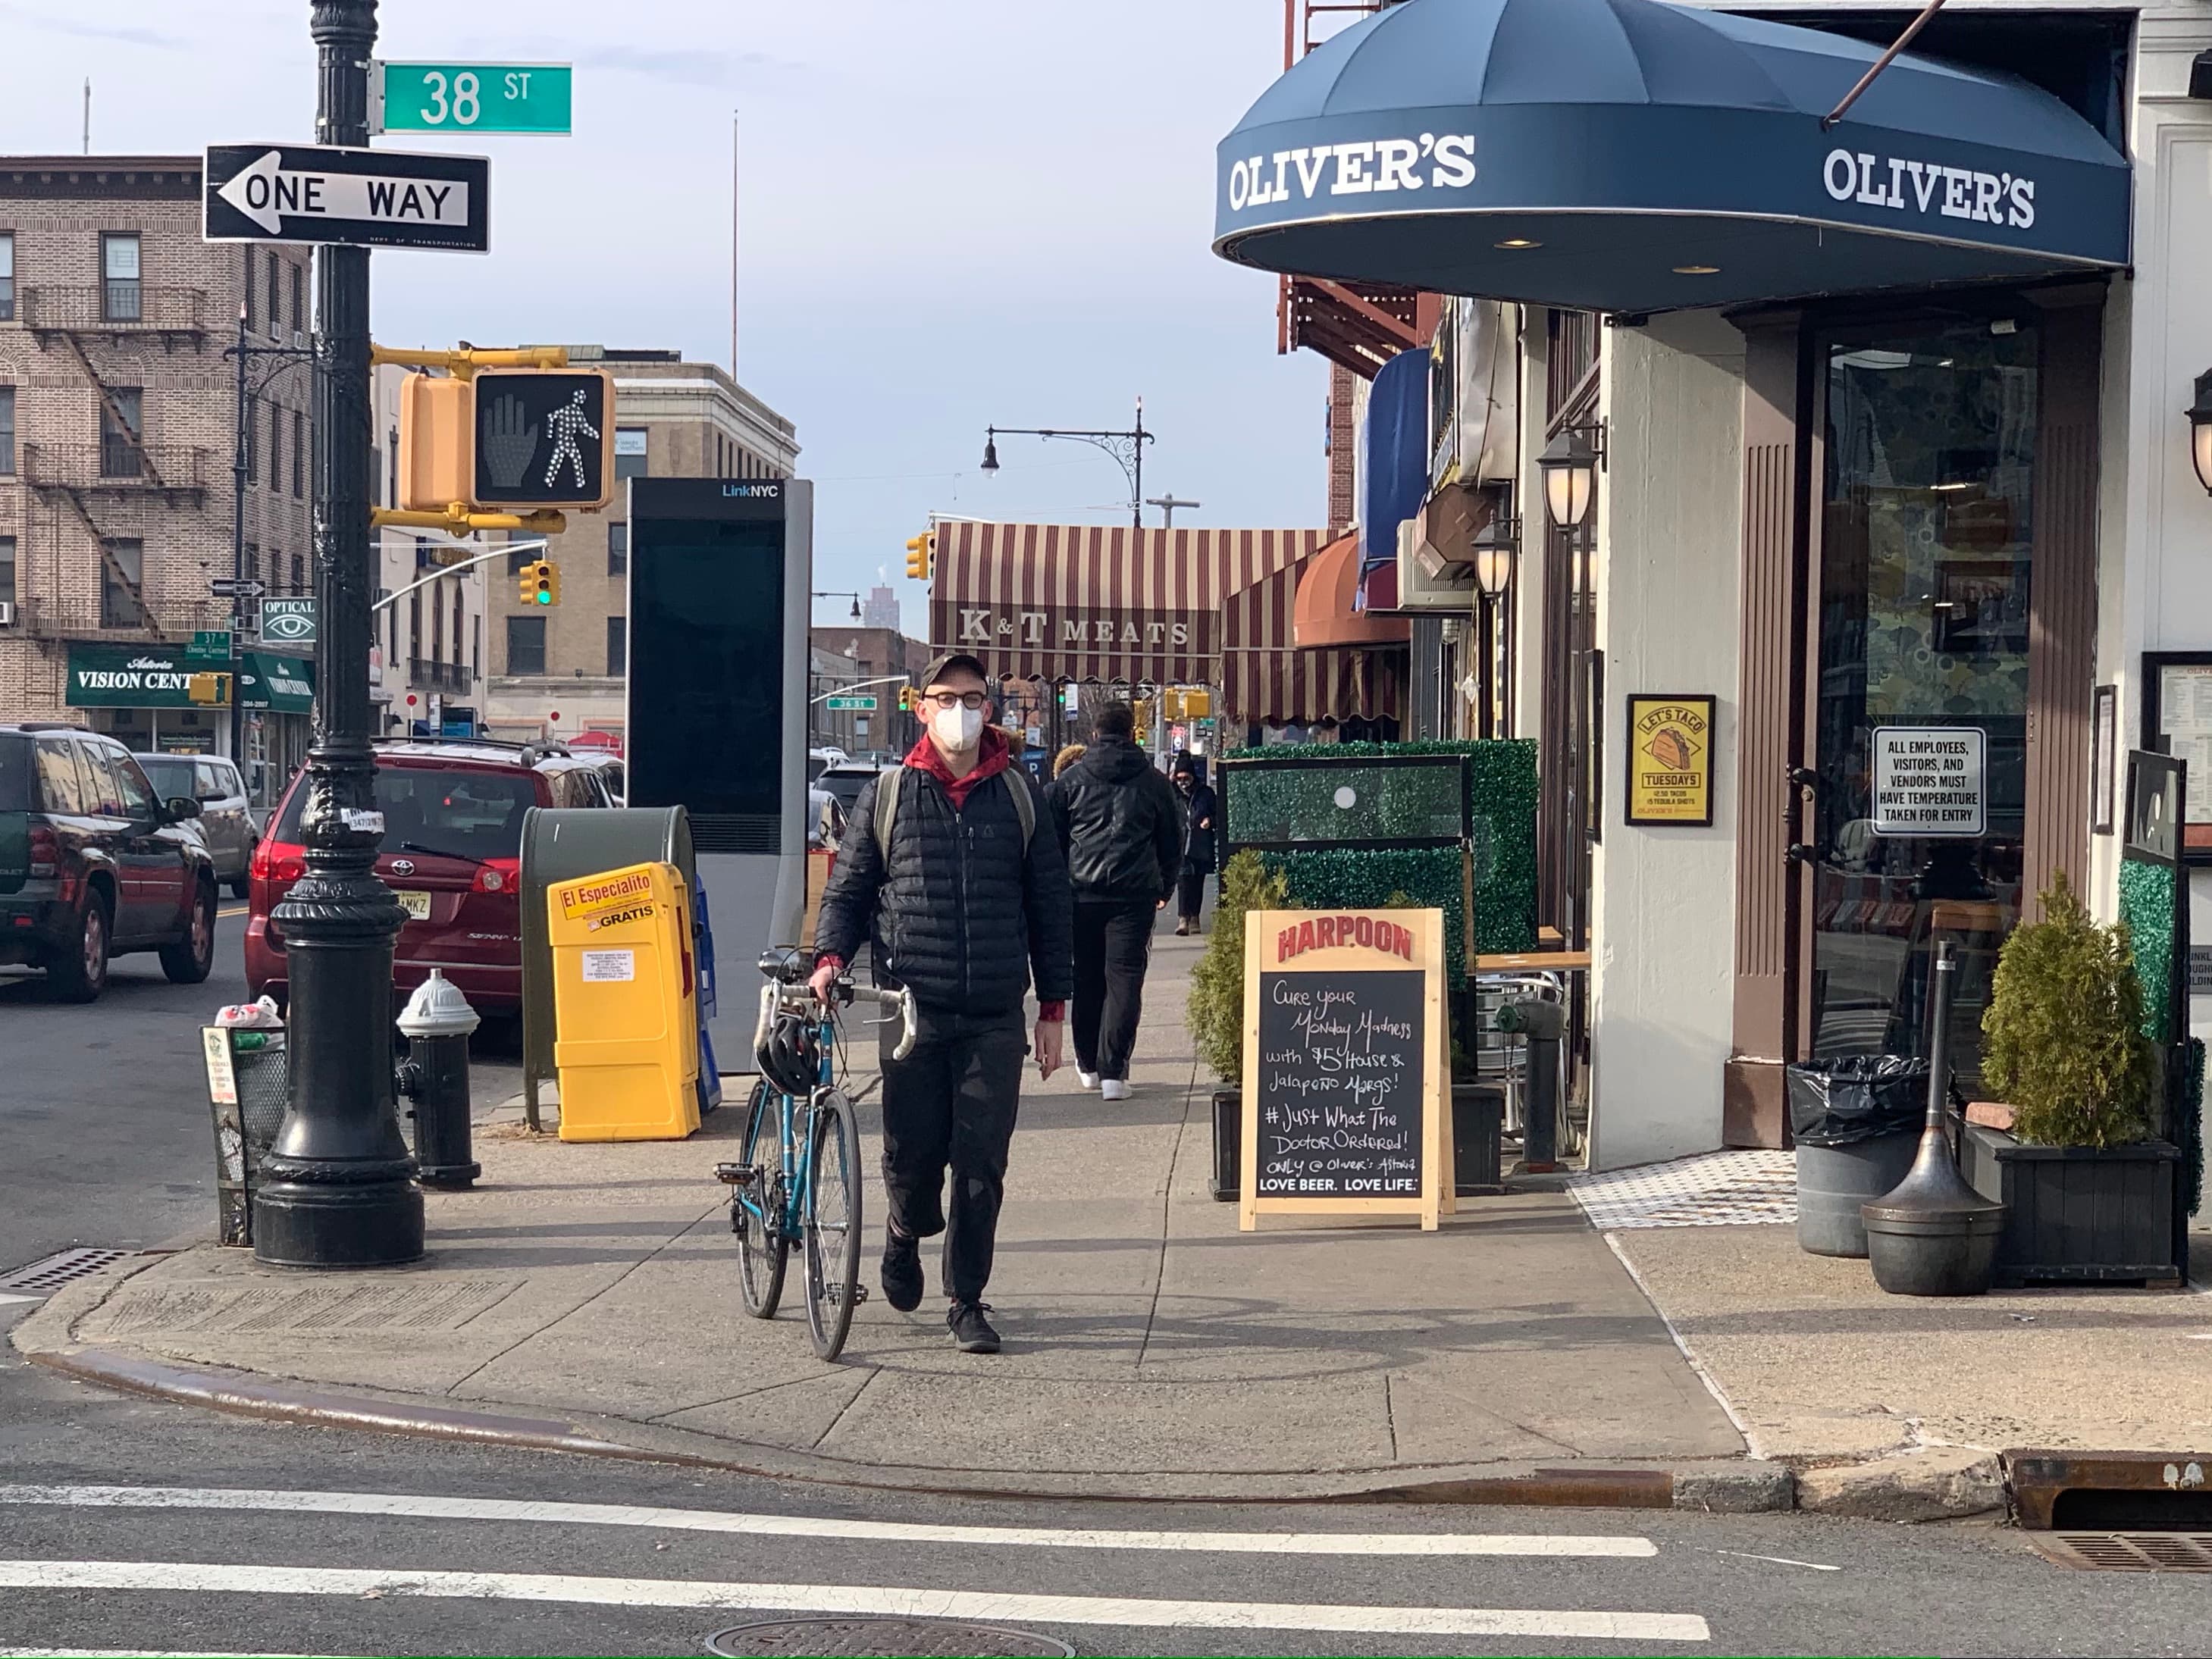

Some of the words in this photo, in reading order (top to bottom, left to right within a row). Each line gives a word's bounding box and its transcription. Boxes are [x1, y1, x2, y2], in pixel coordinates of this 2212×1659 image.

[420, 72, 481, 124] 38
[504, 74, 531, 99] ST
[1230, 133, 1476, 211] OLIVER'S
[1824, 149, 2035, 229] OLIVER'S
[246, 174, 325, 213] ONE
[367, 180, 451, 220] WAY
[413, 239, 476, 247] TRANSPORTATION
[722, 484, 779, 497] LinkNYC
[266, 601, 315, 613] OPTICAL
[205, 634, 217, 643] 37
[1063, 620, 1188, 645] MEATS
[127, 656, 174, 670] Astoria
[77, 671, 141, 689] VISION
[145, 673, 218, 690] CENT
[1642, 709, 1672, 731] LET'S
[1675, 709, 1703, 731] TACO
[1888, 741, 1906, 753] ALL
[1910, 741, 1969, 756] EMPLOYEES,
[1029, 762, 1039, 774] P
[1894, 759, 1941, 772] VISITORS,
[1943, 759, 1963, 771] AND
[1645, 775, 1697, 785] TUESDAYS
[1891, 775, 1936, 787] VENDORS
[1939, 775, 1966, 787] MUST
[1879, 792, 1904, 804] HAVE
[1907, 792, 1978, 805] TEMPERATURE
[1885, 809, 1916, 821] TAKEN
[1919, 809, 1939, 821] FOR
[1942, 809, 1973, 822] ENTRY
[562, 890, 576, 907] El
[578, 875, 650, 903] Especialito
[600, 906, 653, 927] GRATIS
[1278, 916, 1413, 963] HARPOON
[1266, 1049, 1302, 1065] with
[1311, 1047, 1342, 1072] $5
[1325, 1106, 1365, 1128] What
[1368, 1107, 1397, 1131] The
[1309, 1160, 1323, 1172] @
[1260, 1179, 1296, 1191] LOVE
[1299, 1179, 1337, 1191] BEER.
[1345, 1179, 1380, 1191] LOVE
